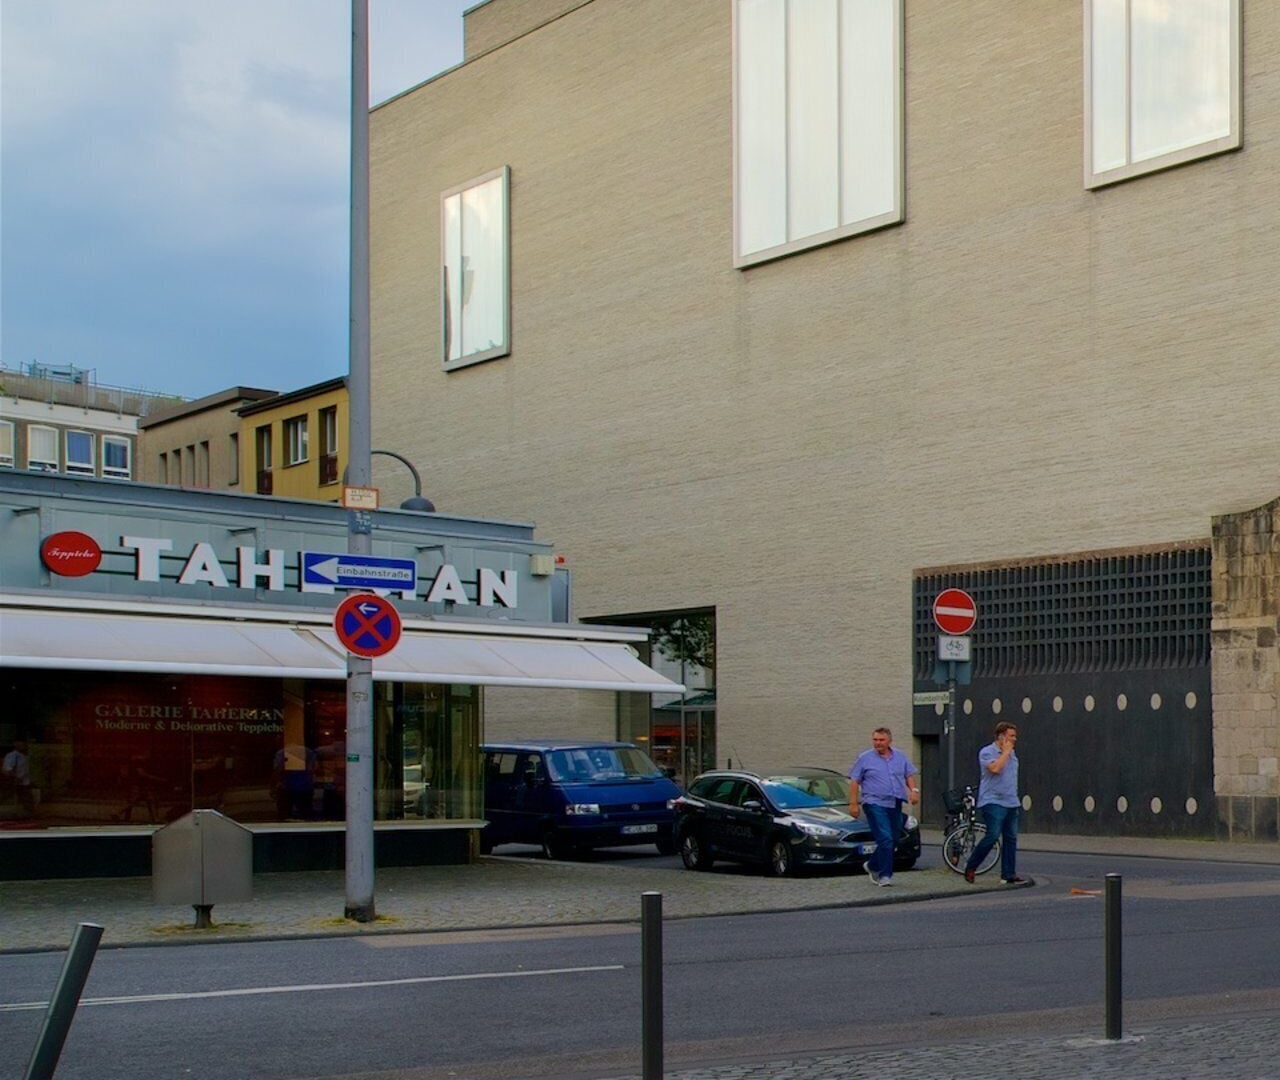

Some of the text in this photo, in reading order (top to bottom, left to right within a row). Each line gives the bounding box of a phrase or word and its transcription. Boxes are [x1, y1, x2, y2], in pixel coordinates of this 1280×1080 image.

[120, 535, 518, 609] TAHAN
[336, 566, 410, 580] Einbahnstraße
[95, 704, 284, 721] GALERIE TAHERIAN
[95, 720, 285, 735] Moderne & Dekorative Teppiche
